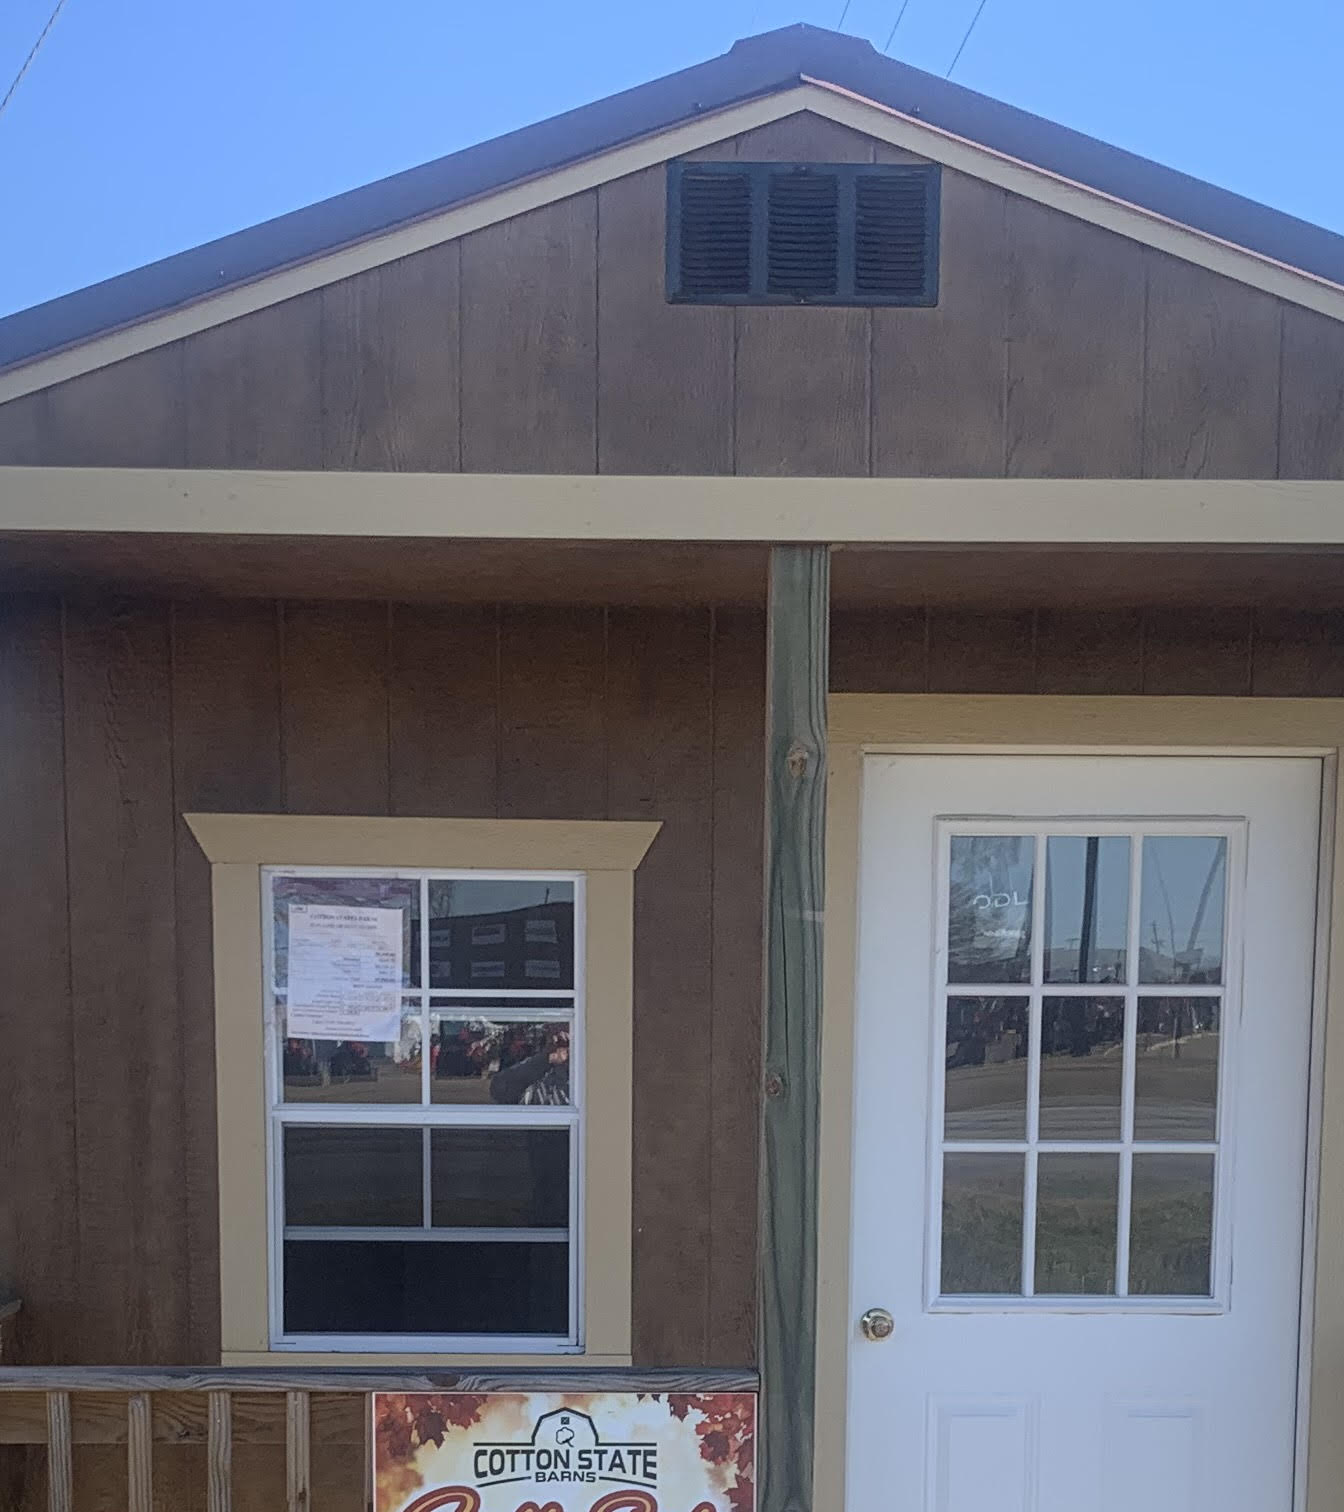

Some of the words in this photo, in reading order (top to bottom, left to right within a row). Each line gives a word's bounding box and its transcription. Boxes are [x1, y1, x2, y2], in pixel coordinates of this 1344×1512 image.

[473, 1449, 571, 1479] COTTON
[577, 1449, 658, 1481] STATE
[535, 1471, 597, 1483] BARNS
